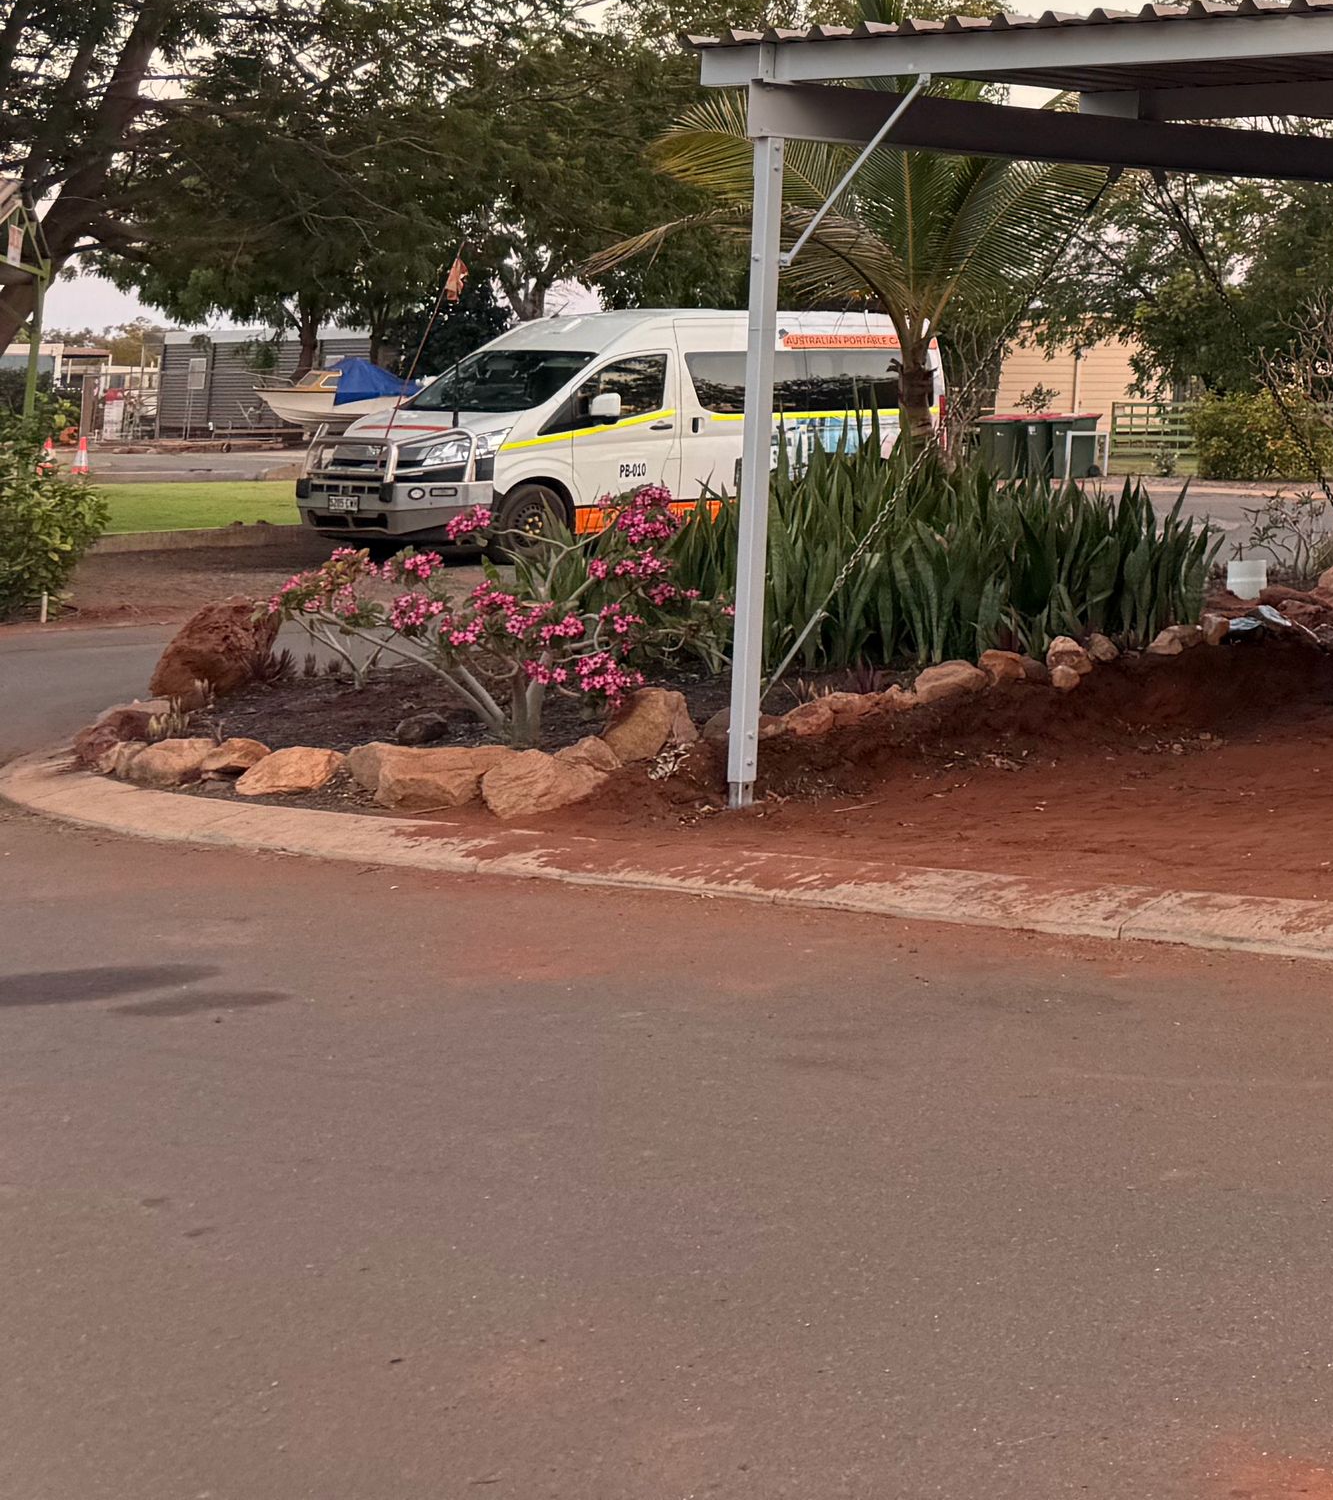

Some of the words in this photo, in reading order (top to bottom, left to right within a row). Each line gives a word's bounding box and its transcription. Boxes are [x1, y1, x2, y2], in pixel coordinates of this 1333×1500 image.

[786, 335, 842, 345] AUSTRALIAN
[844, 335, 887, 345] PORTABLE
[620, 463, 647, 478] PB-010
